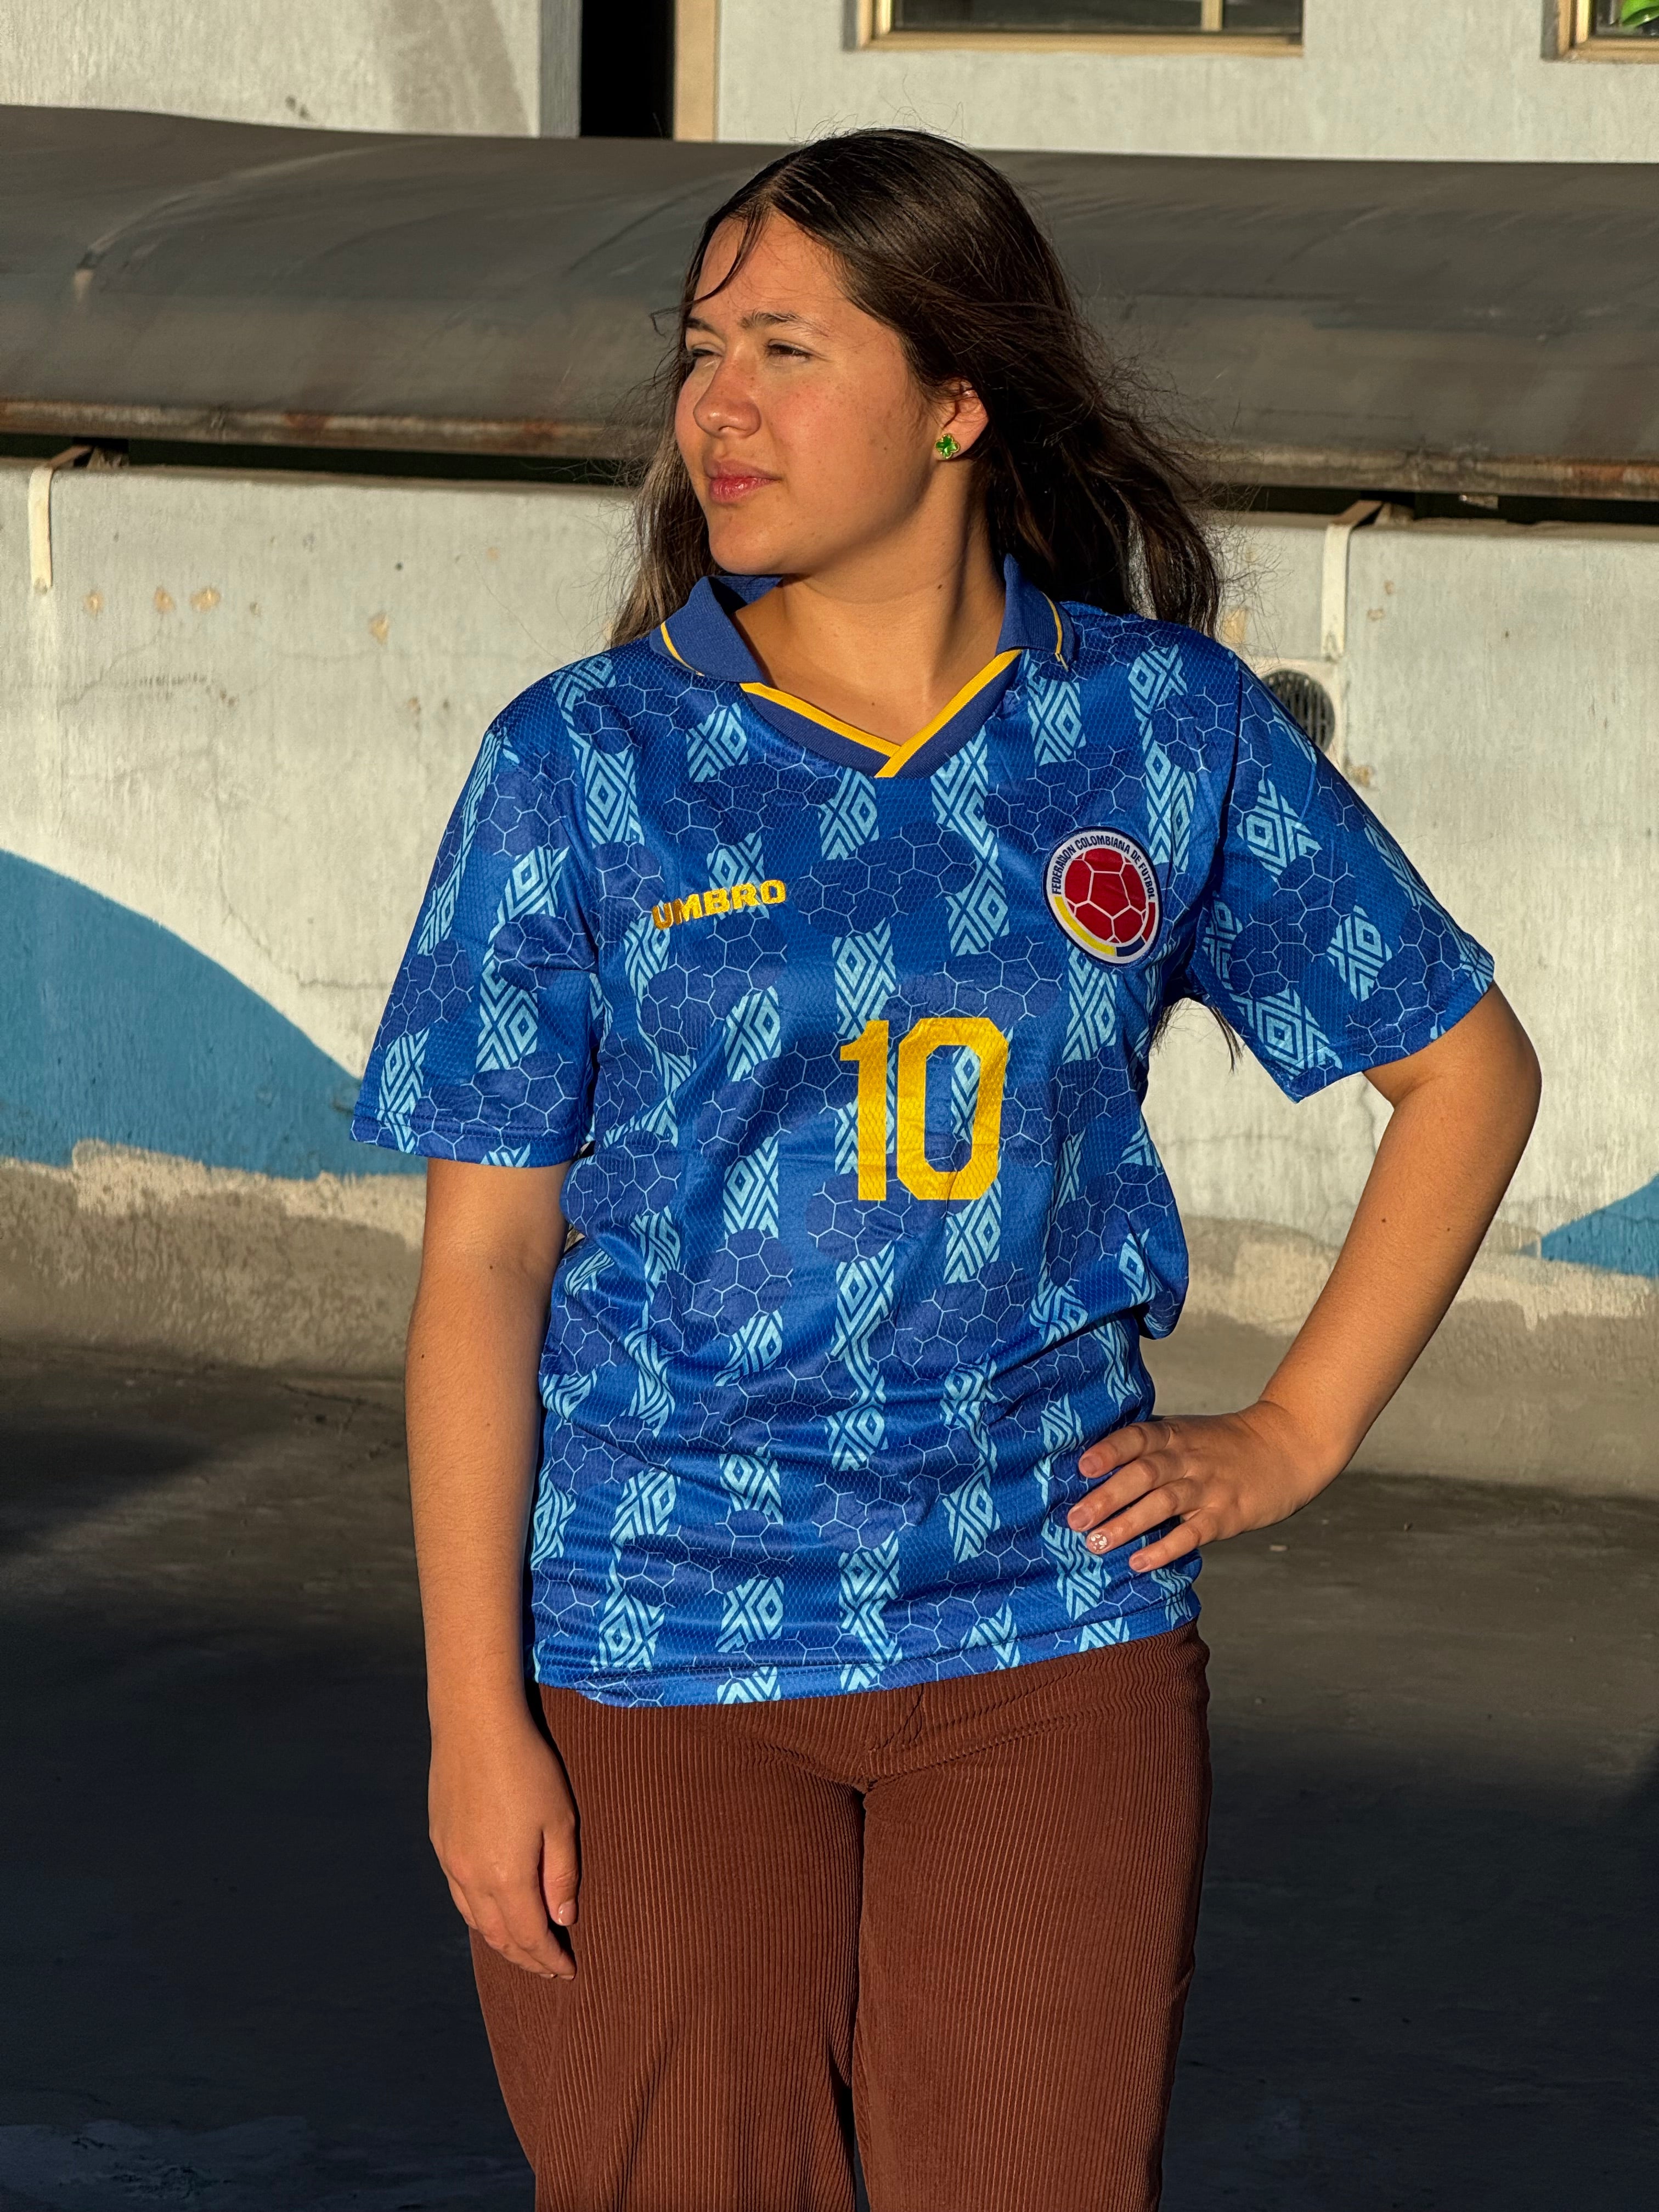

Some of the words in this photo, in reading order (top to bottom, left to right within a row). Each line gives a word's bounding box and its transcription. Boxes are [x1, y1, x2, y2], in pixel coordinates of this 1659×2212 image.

[1074, 835, 1131, 855] COLOMBIANA
[1130, 849, 1142, 865] DE
[1138, 862, 1155, 900] FUTBOL
[651, 879, 787, 930] UMBRO
[839, 1017, 1009, 1201] 10
